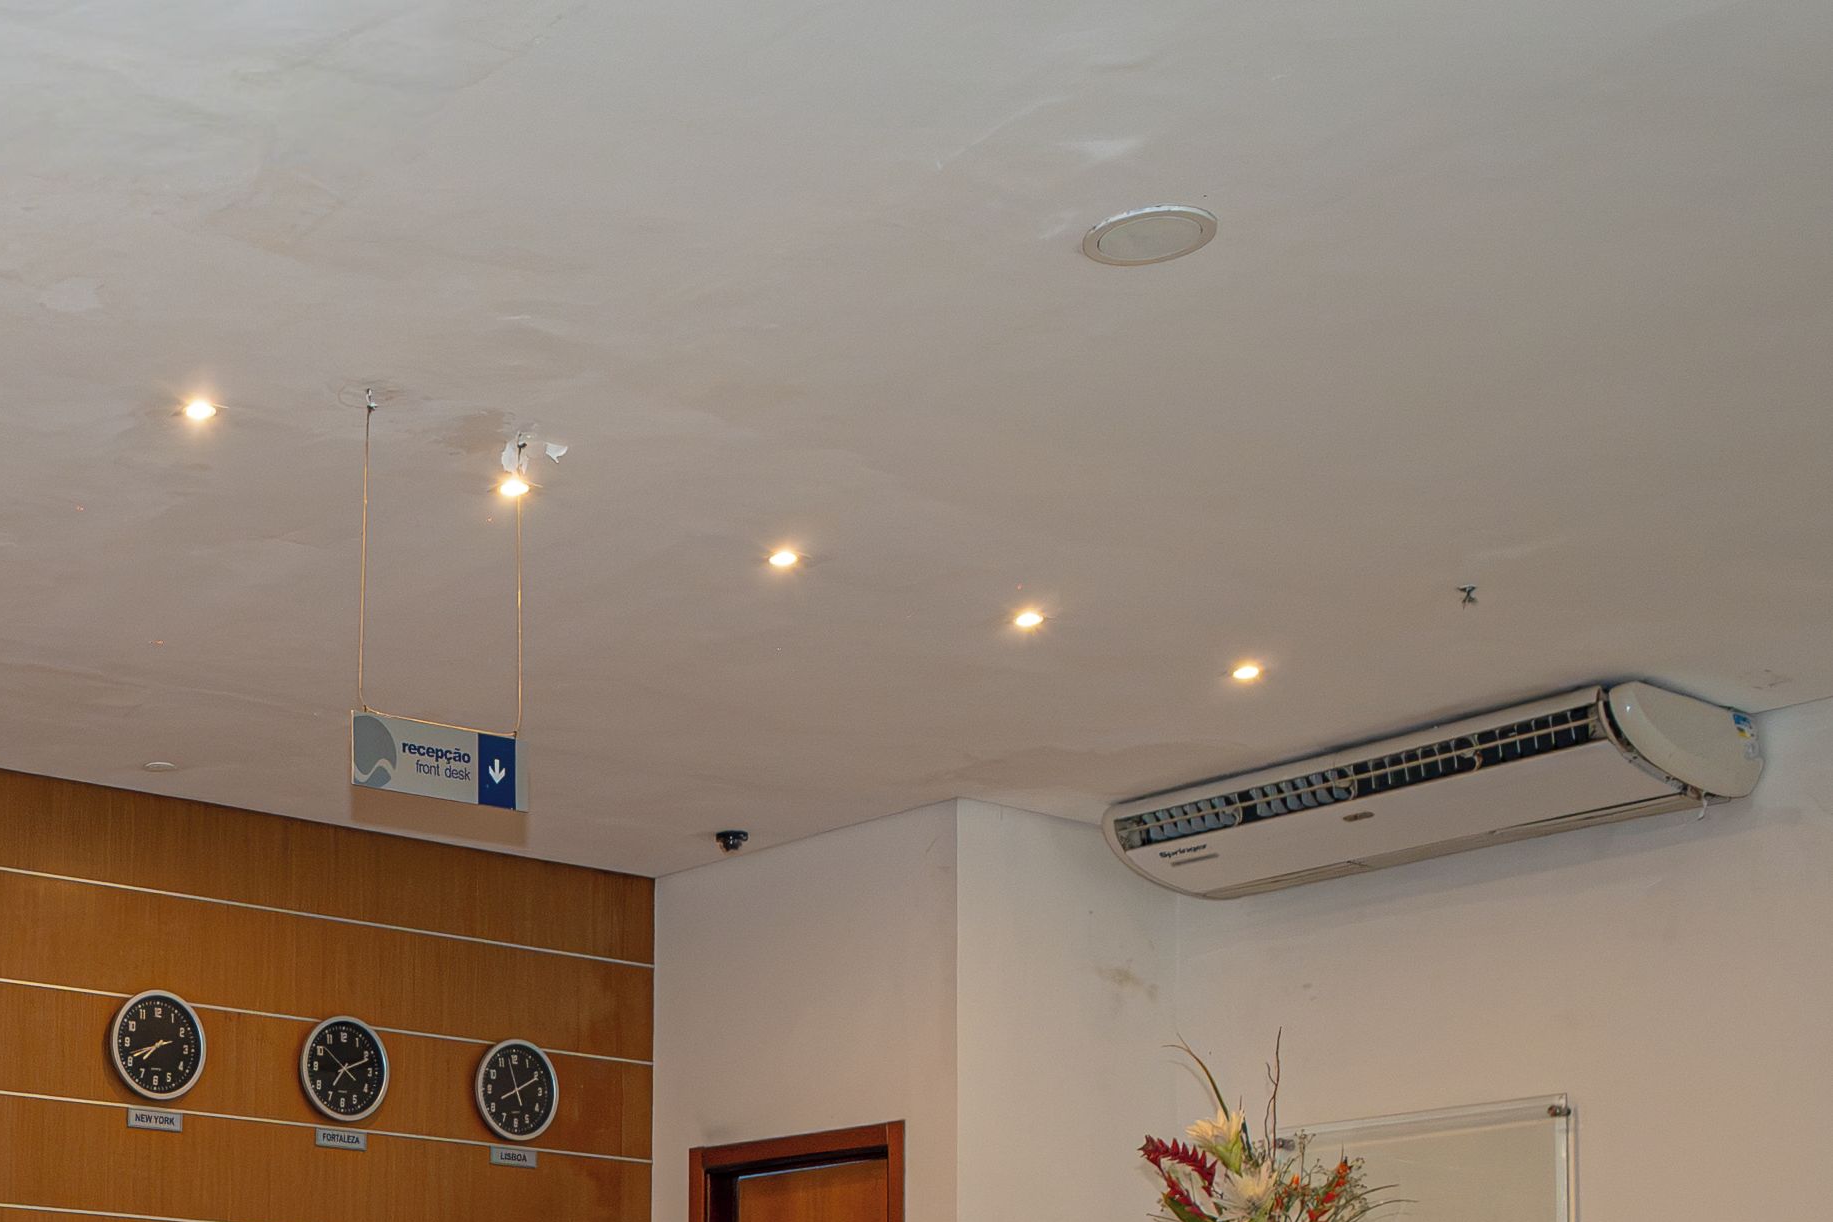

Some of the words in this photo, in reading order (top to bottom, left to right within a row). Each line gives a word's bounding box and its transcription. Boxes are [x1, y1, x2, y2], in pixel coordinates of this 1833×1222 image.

[402, 742, 471, 764] recepção
[415, 759, 440, 777] front
[444, 765, 471, 781] desk
[135, 1113, 152, 1124] NEW
[153, 1115, 175, 1126] YORK
[322, 1132, 360, 1145] FORTALEZA
[500, 1152, 527, 1162] LISBOA
